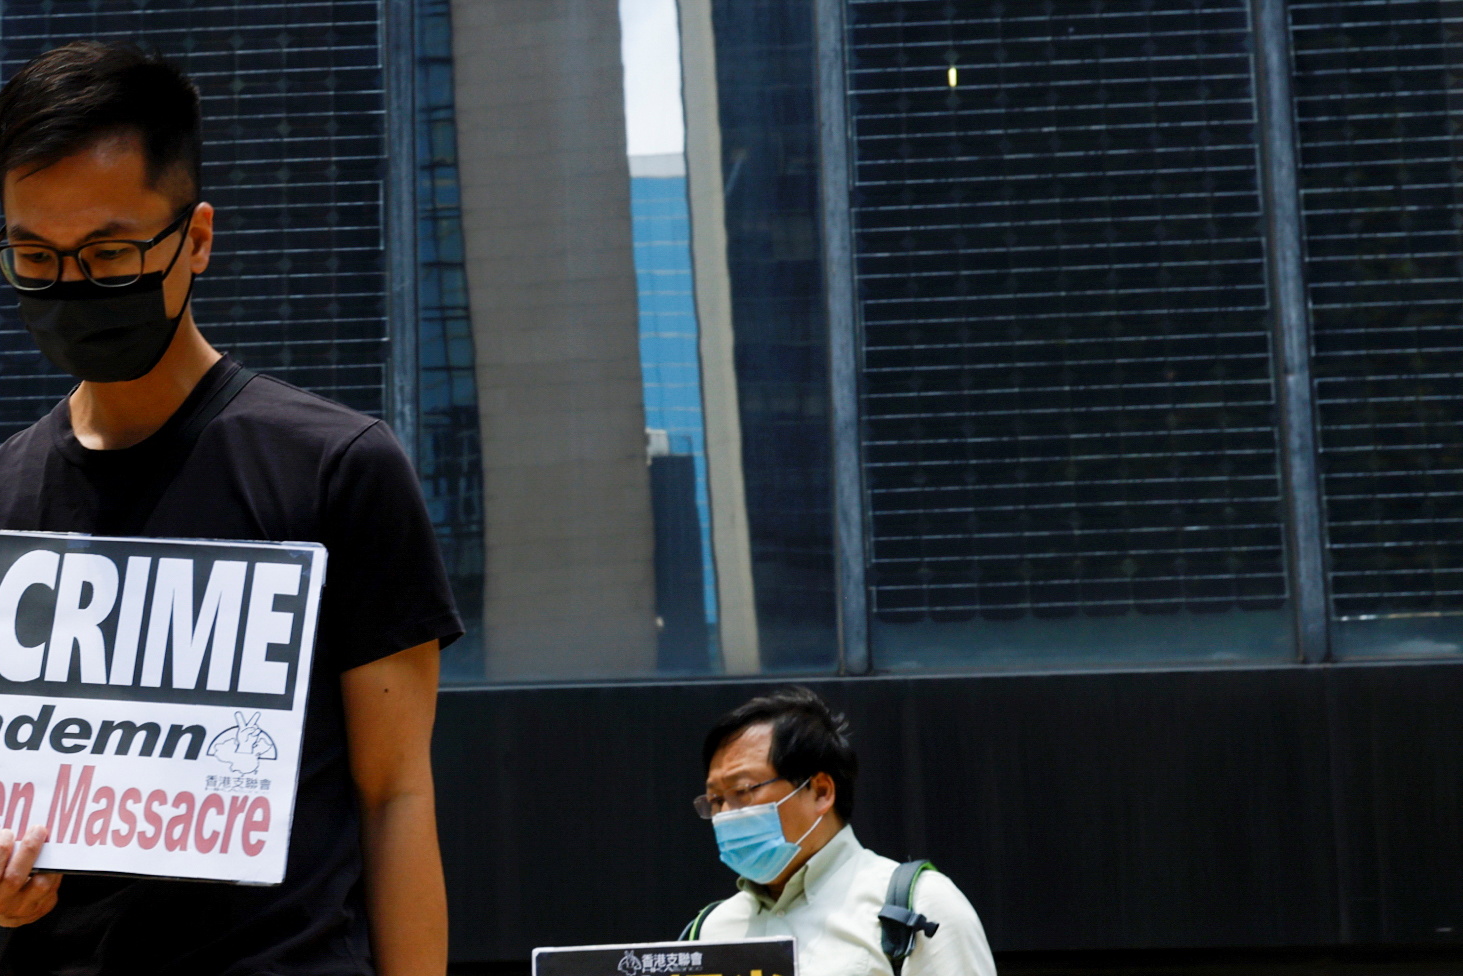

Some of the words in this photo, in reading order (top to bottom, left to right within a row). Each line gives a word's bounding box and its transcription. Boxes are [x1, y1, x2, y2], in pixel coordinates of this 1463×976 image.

[46, 764, 271, 857] Massacre
[641, 951, 703, 967] 香港支聯會
